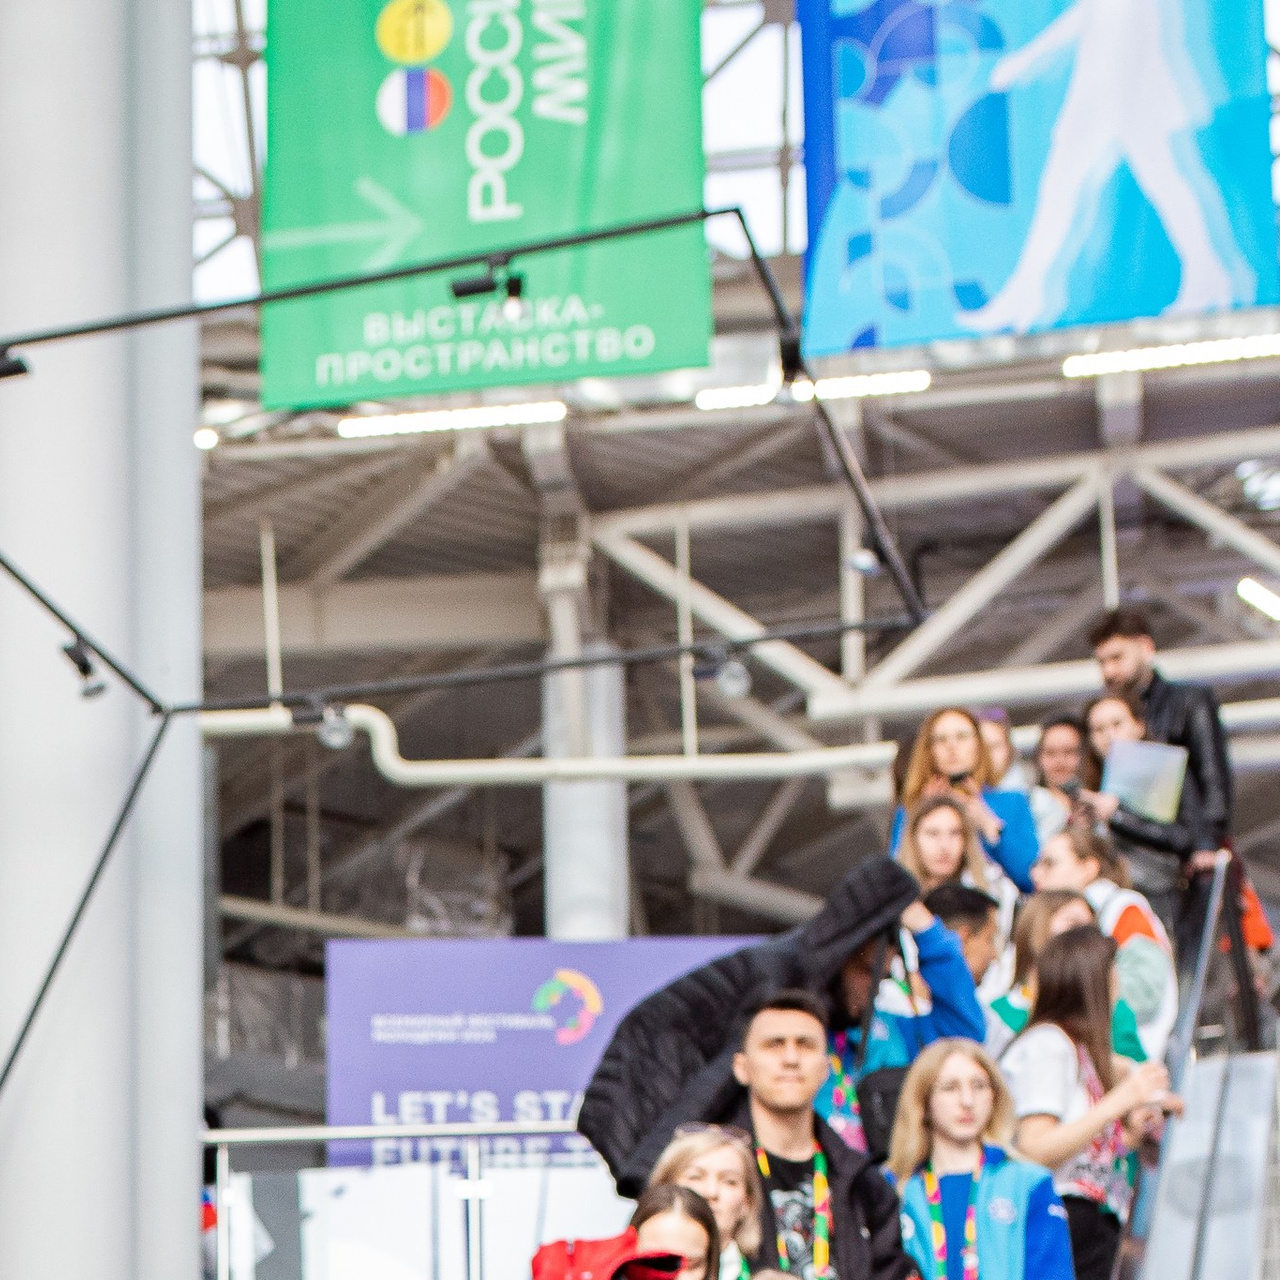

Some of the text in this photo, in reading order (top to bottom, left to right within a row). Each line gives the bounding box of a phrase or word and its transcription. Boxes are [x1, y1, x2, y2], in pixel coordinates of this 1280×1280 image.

[532, 0, 588, 125] МИ
[465, 0, 524, 224] РОСС
[315, 324, 656, 386] ПРОСТРАНСТВО
[371, 1089, 500, 1125] LET'S
